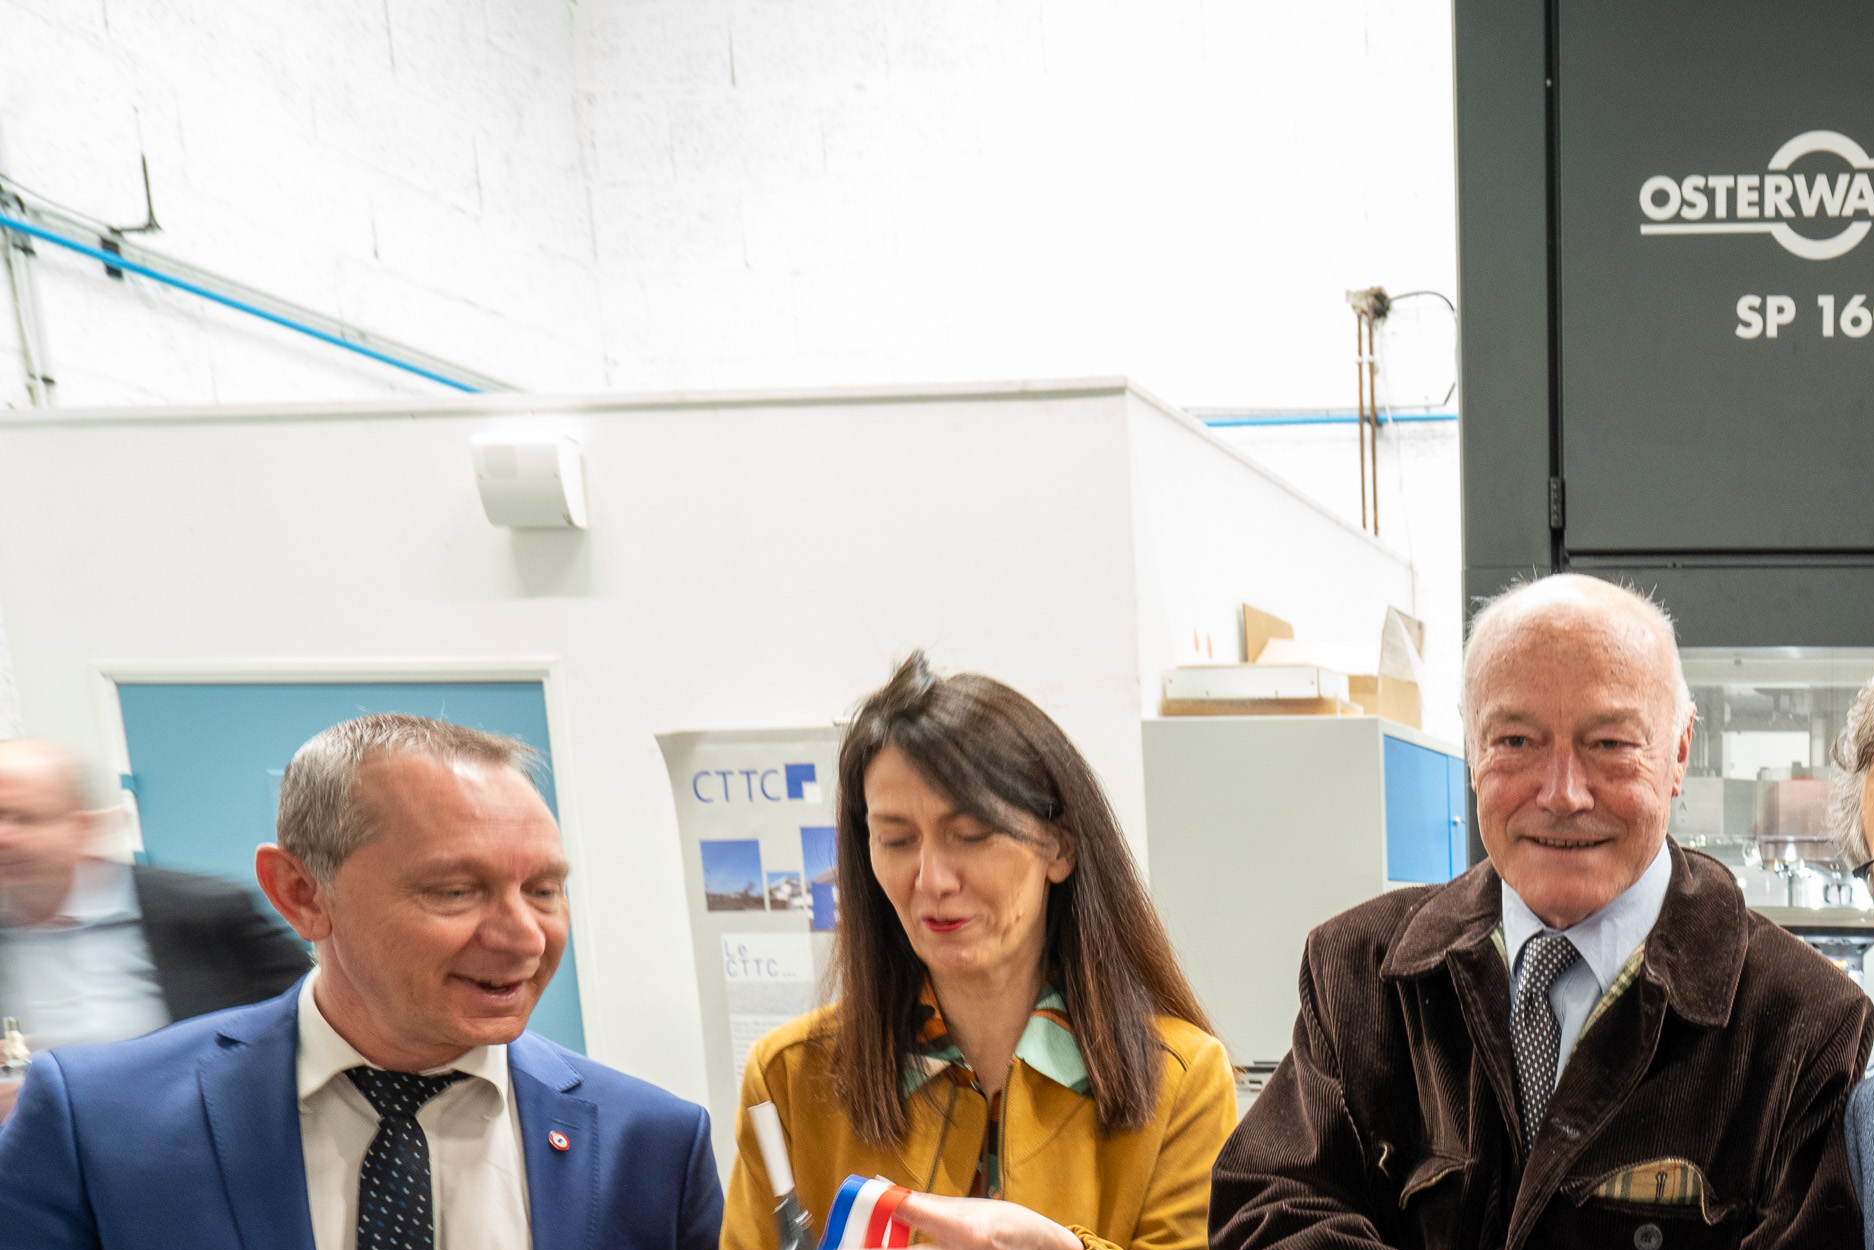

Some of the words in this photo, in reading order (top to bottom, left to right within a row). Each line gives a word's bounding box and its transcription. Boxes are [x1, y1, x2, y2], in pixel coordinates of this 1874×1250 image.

[1735, 293, 1797, 340] SP
[692, 768, 782, 804] CTTC
[723, 939, 748, 958] Le
